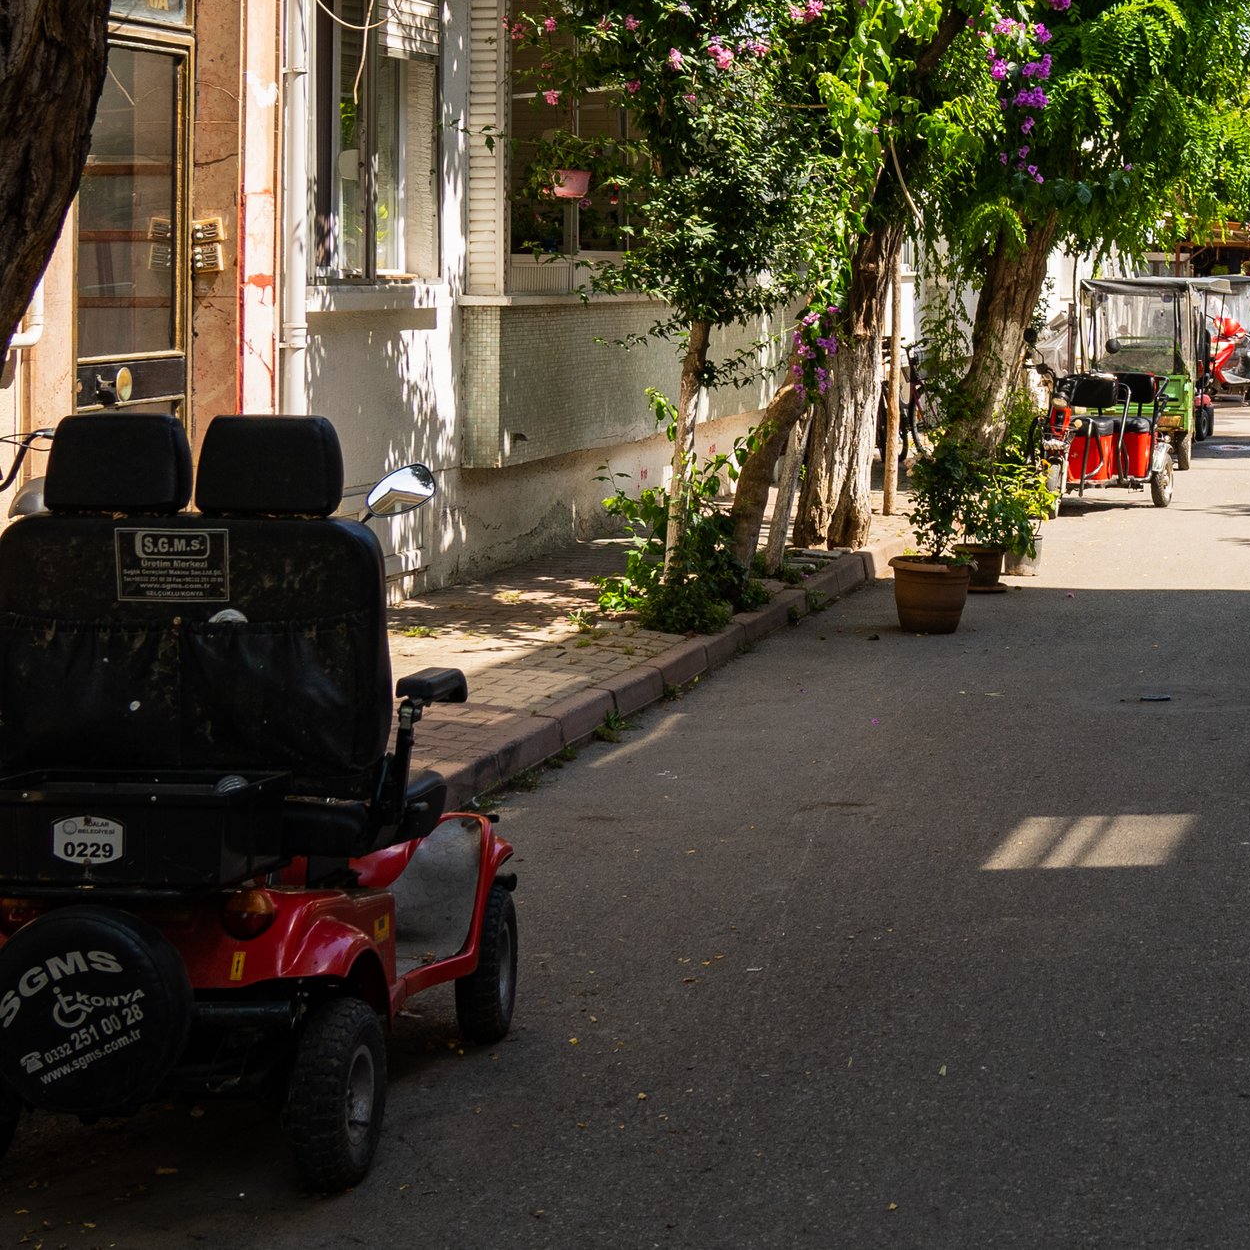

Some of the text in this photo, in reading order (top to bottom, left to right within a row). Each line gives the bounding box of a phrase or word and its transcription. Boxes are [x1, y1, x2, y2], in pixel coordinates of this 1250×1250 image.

[63, 841, 114, 858] 0229
[0, 950, 124, 1028] SGMS
[76, 988, 145, 1007] KONYA
[39, 1028, 142, 1085] www.sgms.com.tr
[44, 1003, 144, 1064] 0332 251 00 28
